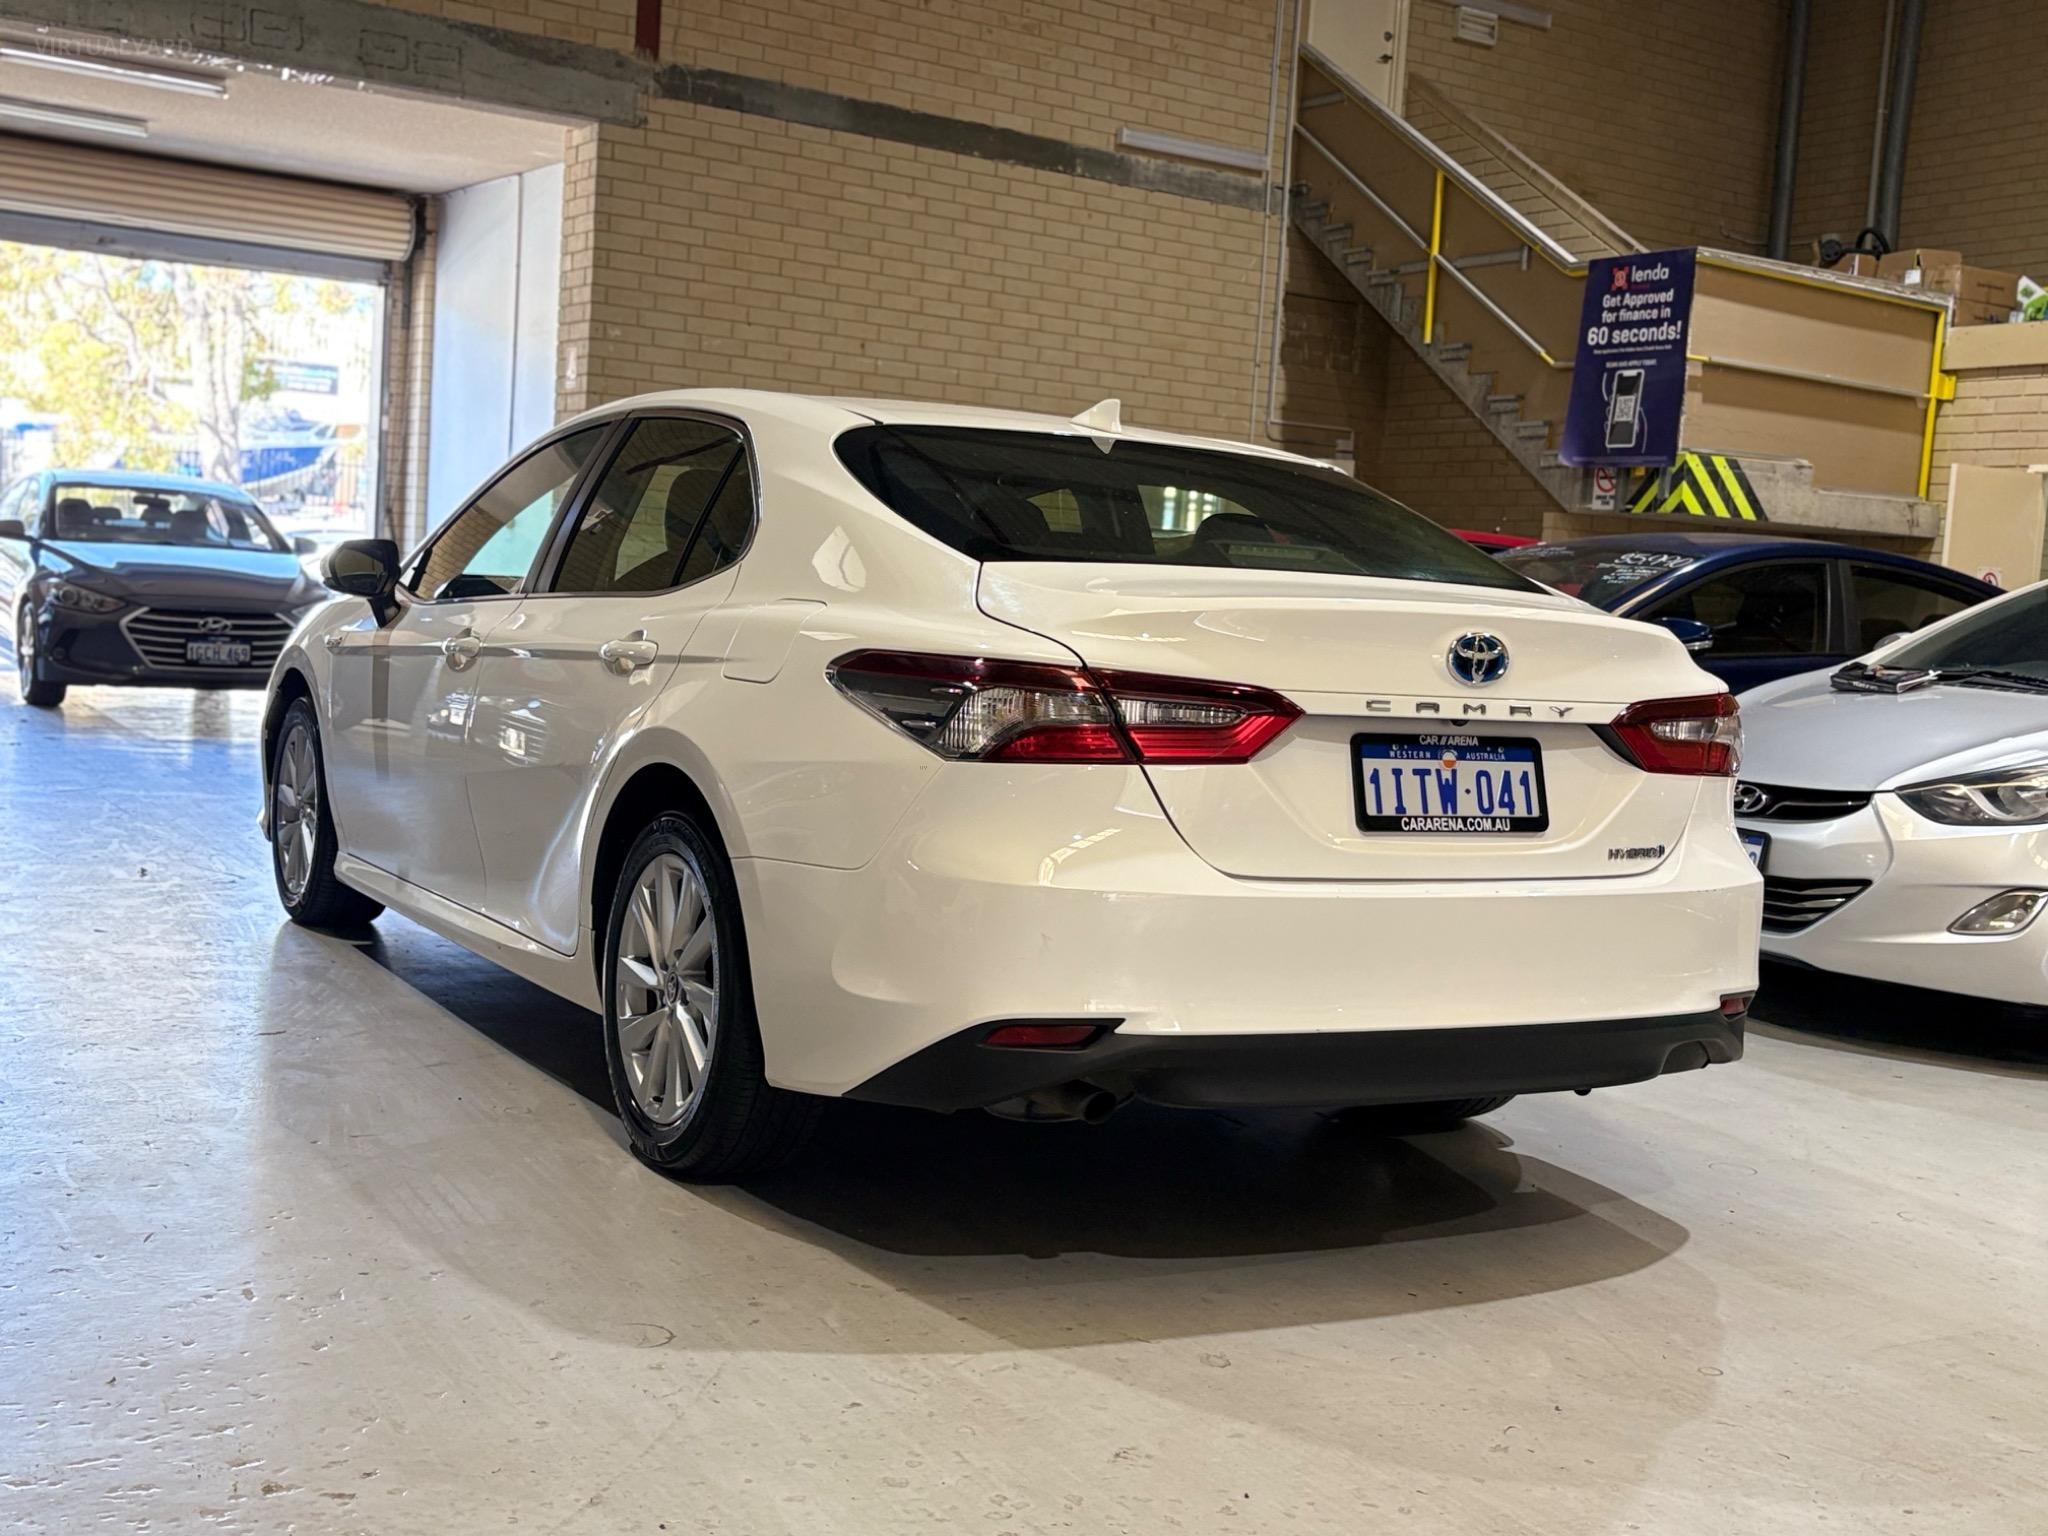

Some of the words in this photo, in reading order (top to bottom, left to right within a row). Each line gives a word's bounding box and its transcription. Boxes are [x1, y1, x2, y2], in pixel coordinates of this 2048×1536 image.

[1631, 262, 1669, 282] lenda
[1602, 294, 1621, 308] Get
[1622, 288, 1674, 308] Approved
[1601, 310, 1617, 323] for
[1618, 308, 1658, 322] finance
[1660, 305, 1671, 318] in
[1587, 326, 1609, 346] 60
[1611, 320, 1682, 344] seconds!
[1366, 700, 1574, 718] CAMRY
[1389, 750, 1431, 759] WESTERN
[1465, 752, 1506, 761] AUSTRALIA
[1401, 817, 1511, 832] CARARENA.COM.AU
